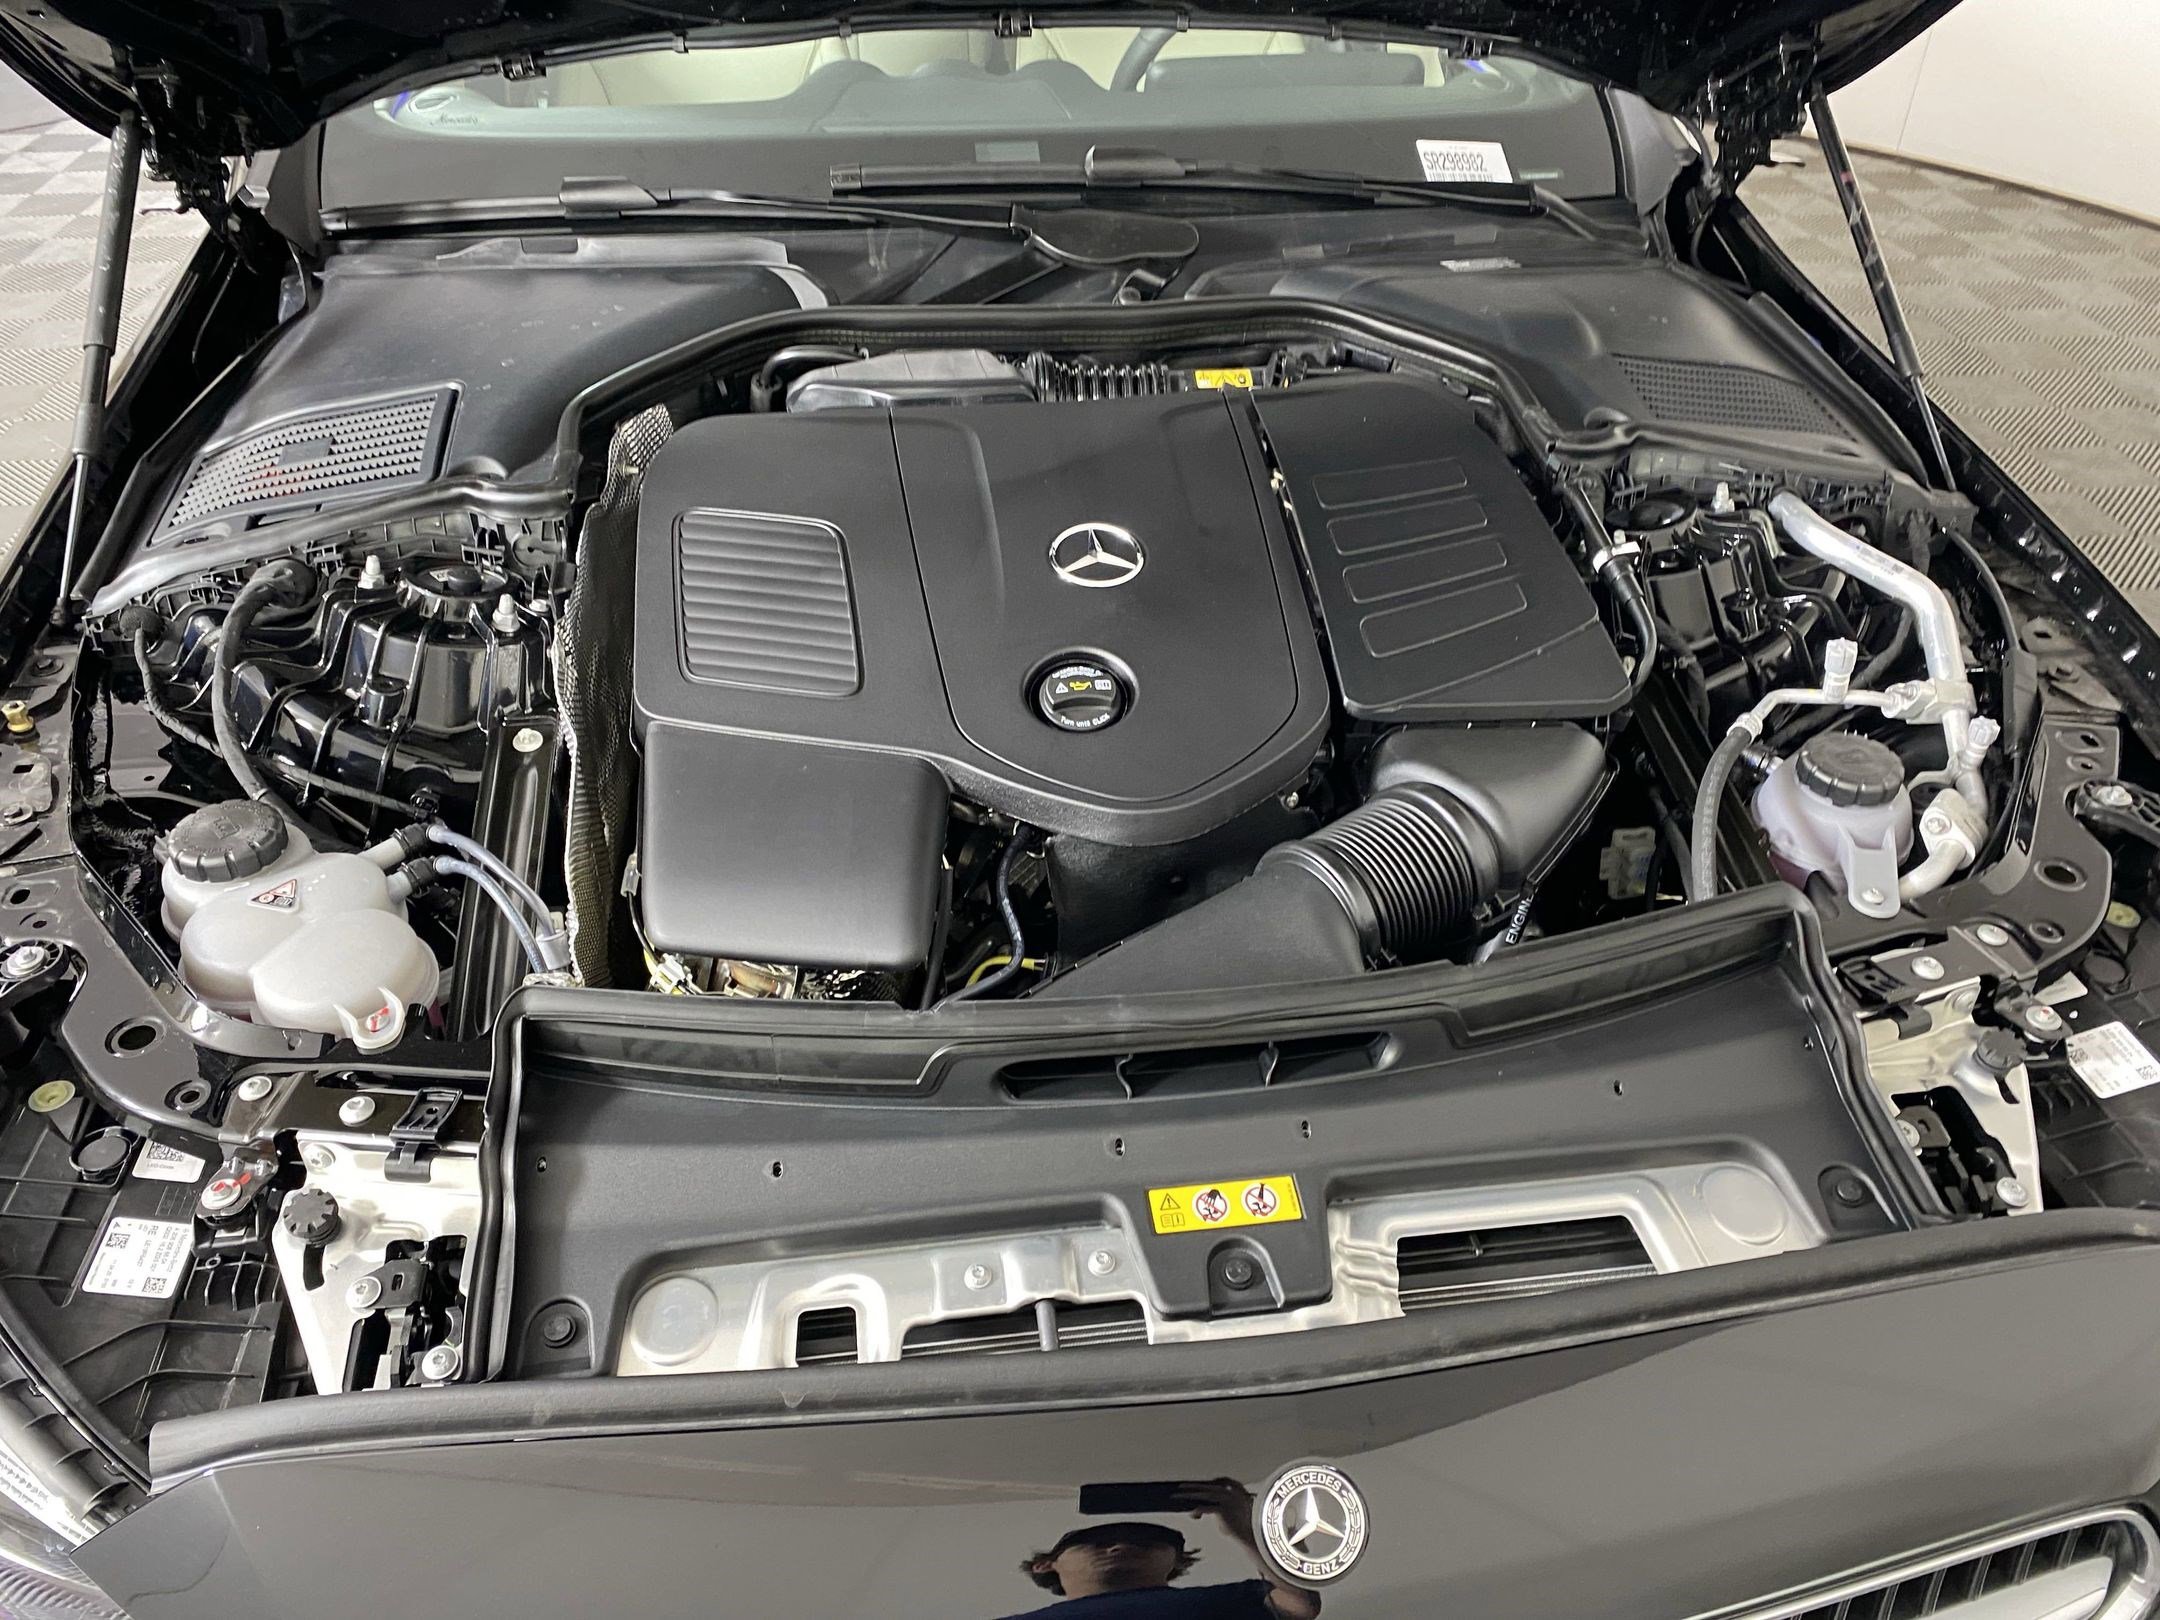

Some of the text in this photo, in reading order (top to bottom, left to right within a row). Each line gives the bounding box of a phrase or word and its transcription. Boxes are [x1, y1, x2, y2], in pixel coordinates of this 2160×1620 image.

[1423, 151, 1488, 172] SR298982
[1060, 715, 1075, 727] Turn
[1092, 712, 1111, 726] CLICK
[1277, 1472, 1342, 1500] MERCEDES
[1303, 1559, 1341, 1575] BENZ
